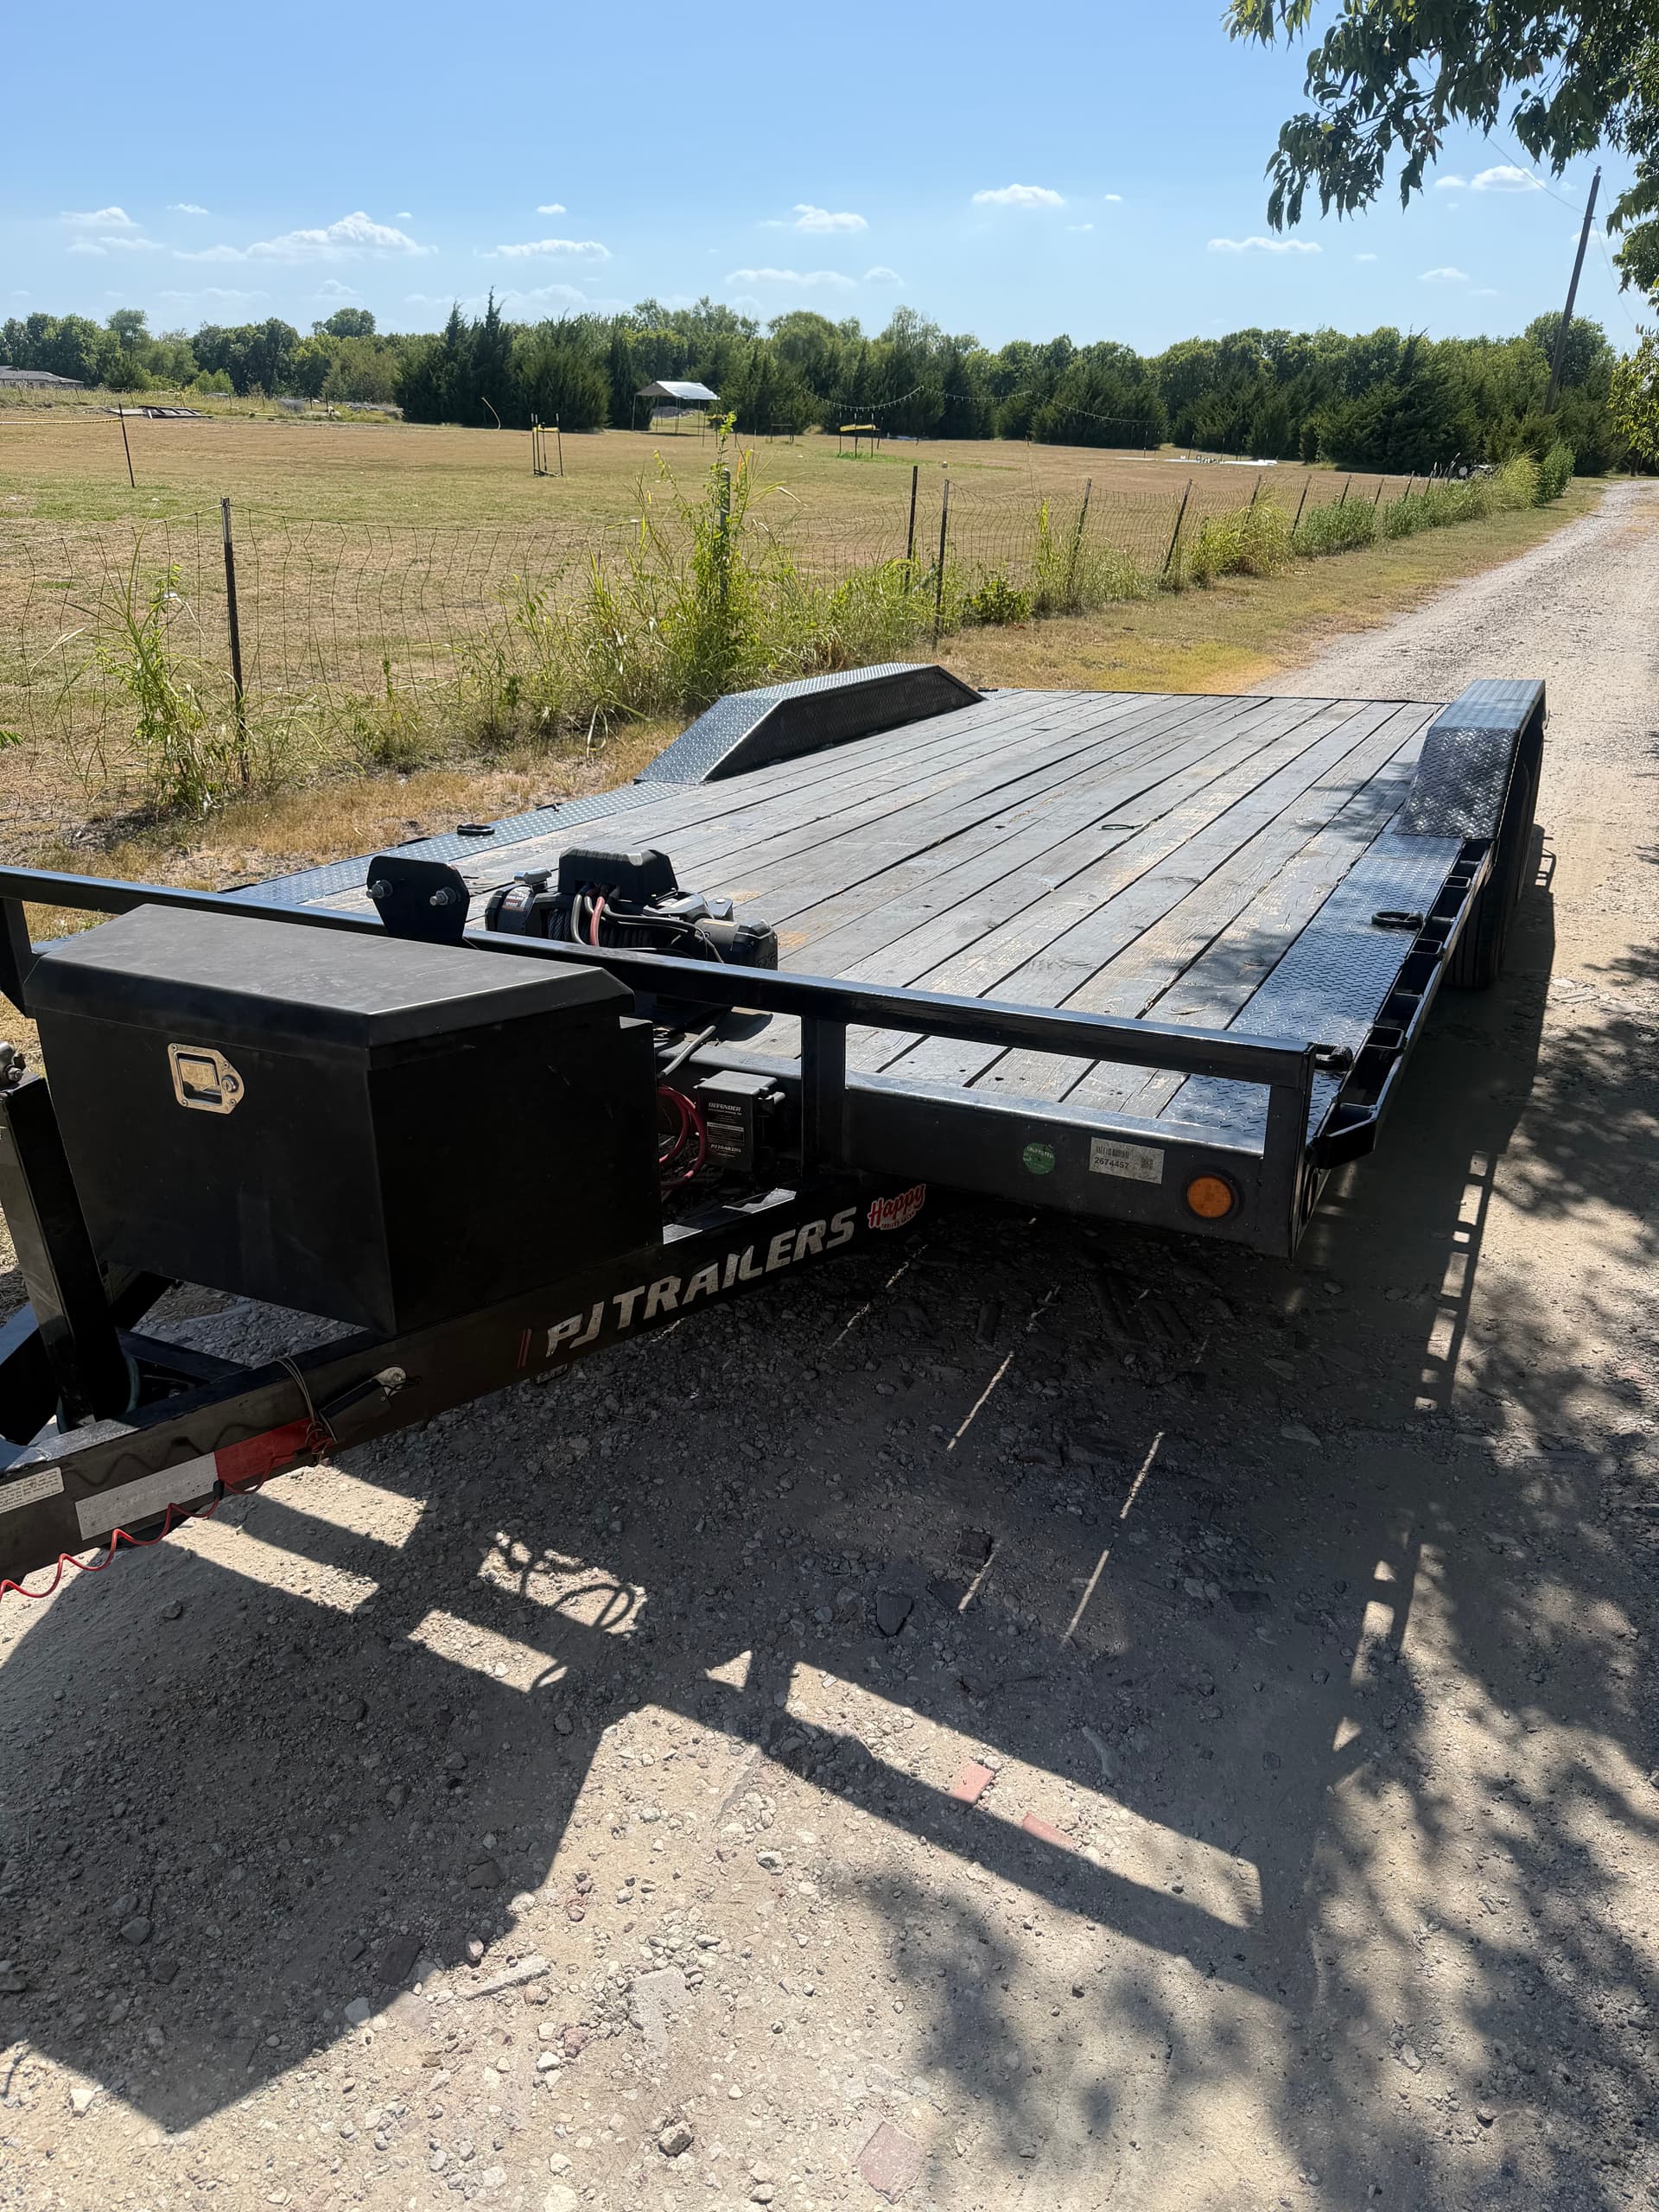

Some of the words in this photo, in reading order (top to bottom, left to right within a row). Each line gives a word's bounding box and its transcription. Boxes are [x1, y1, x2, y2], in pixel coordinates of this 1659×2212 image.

[1094, 1157, 1129, 1169] 2674457
[868, 1184, 926, 1228] Happy
[545, 1302, 605, 1357] PJ
[612, 1206, 858, 1331] TRAILERS
